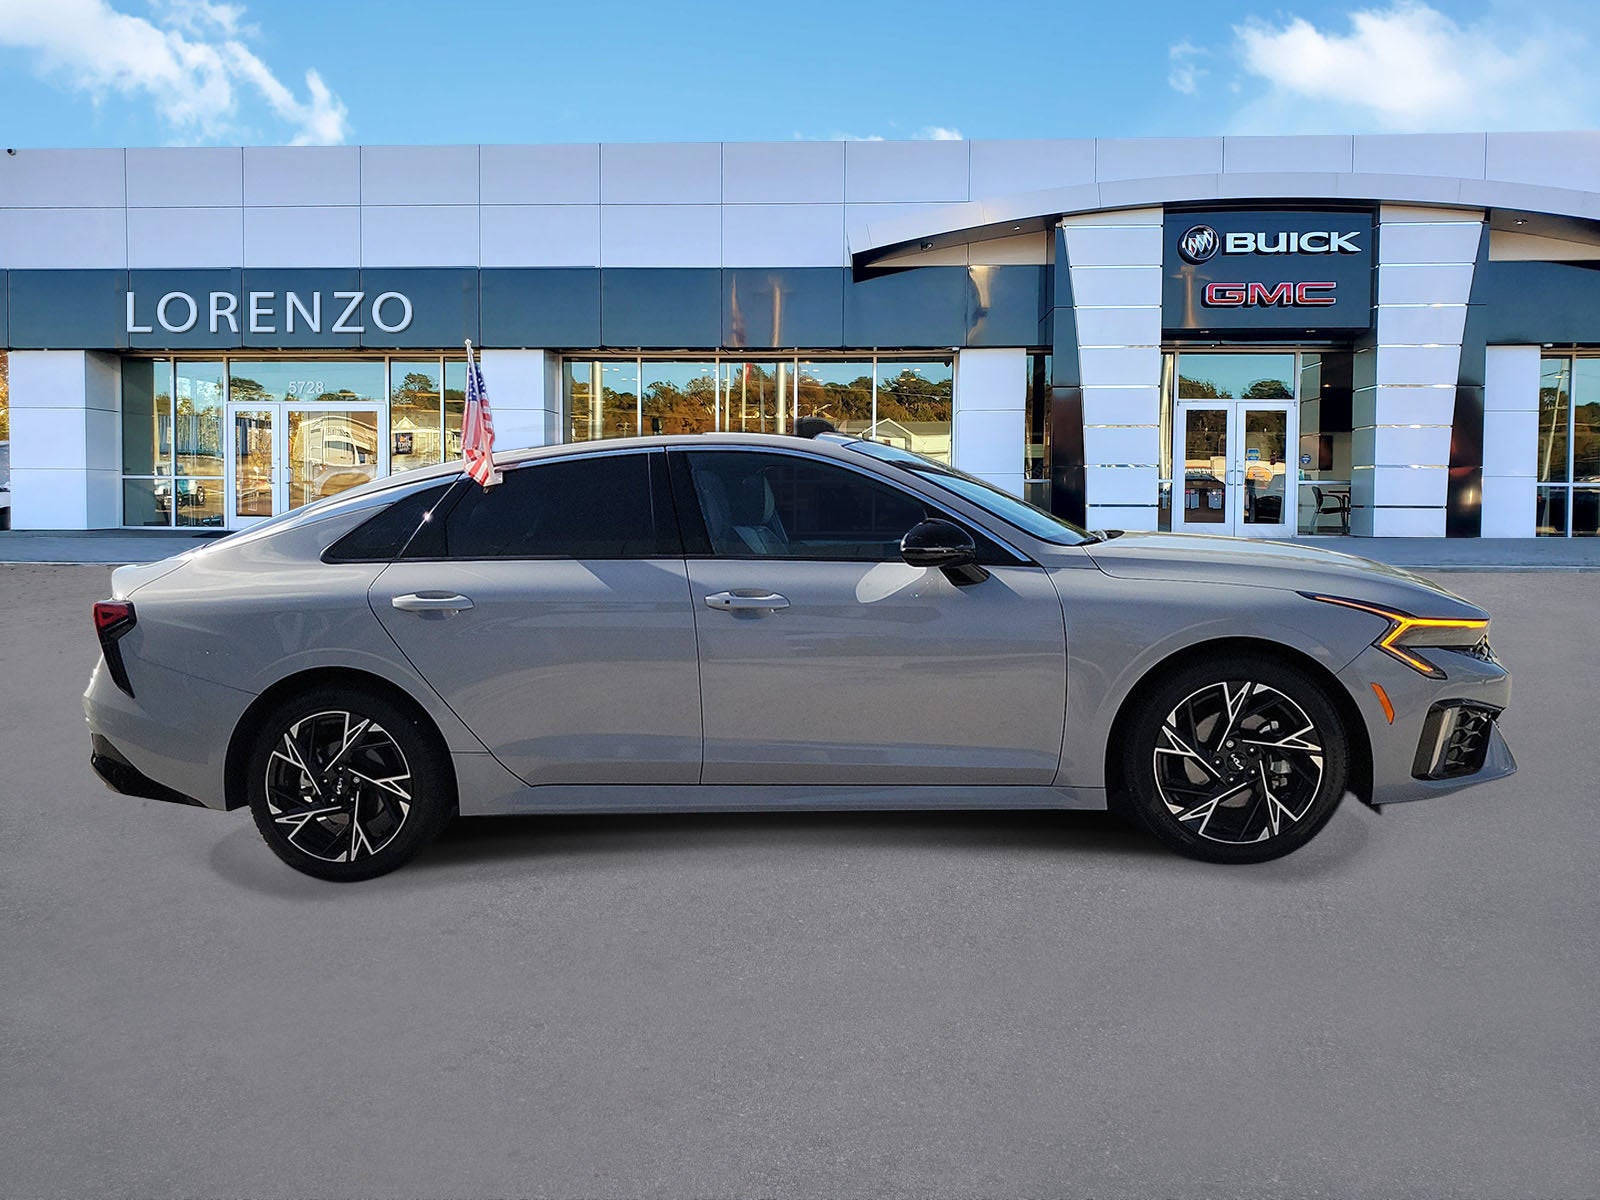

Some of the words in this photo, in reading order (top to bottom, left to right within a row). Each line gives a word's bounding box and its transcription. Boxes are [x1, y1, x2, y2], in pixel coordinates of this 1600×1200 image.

[1224, 231, 1362, 254] BUICK
[1205, 281, 1337, 306] GMC
[125, 290, 414, 334] LORENZO
[288, 380, 325, 395] 5728
